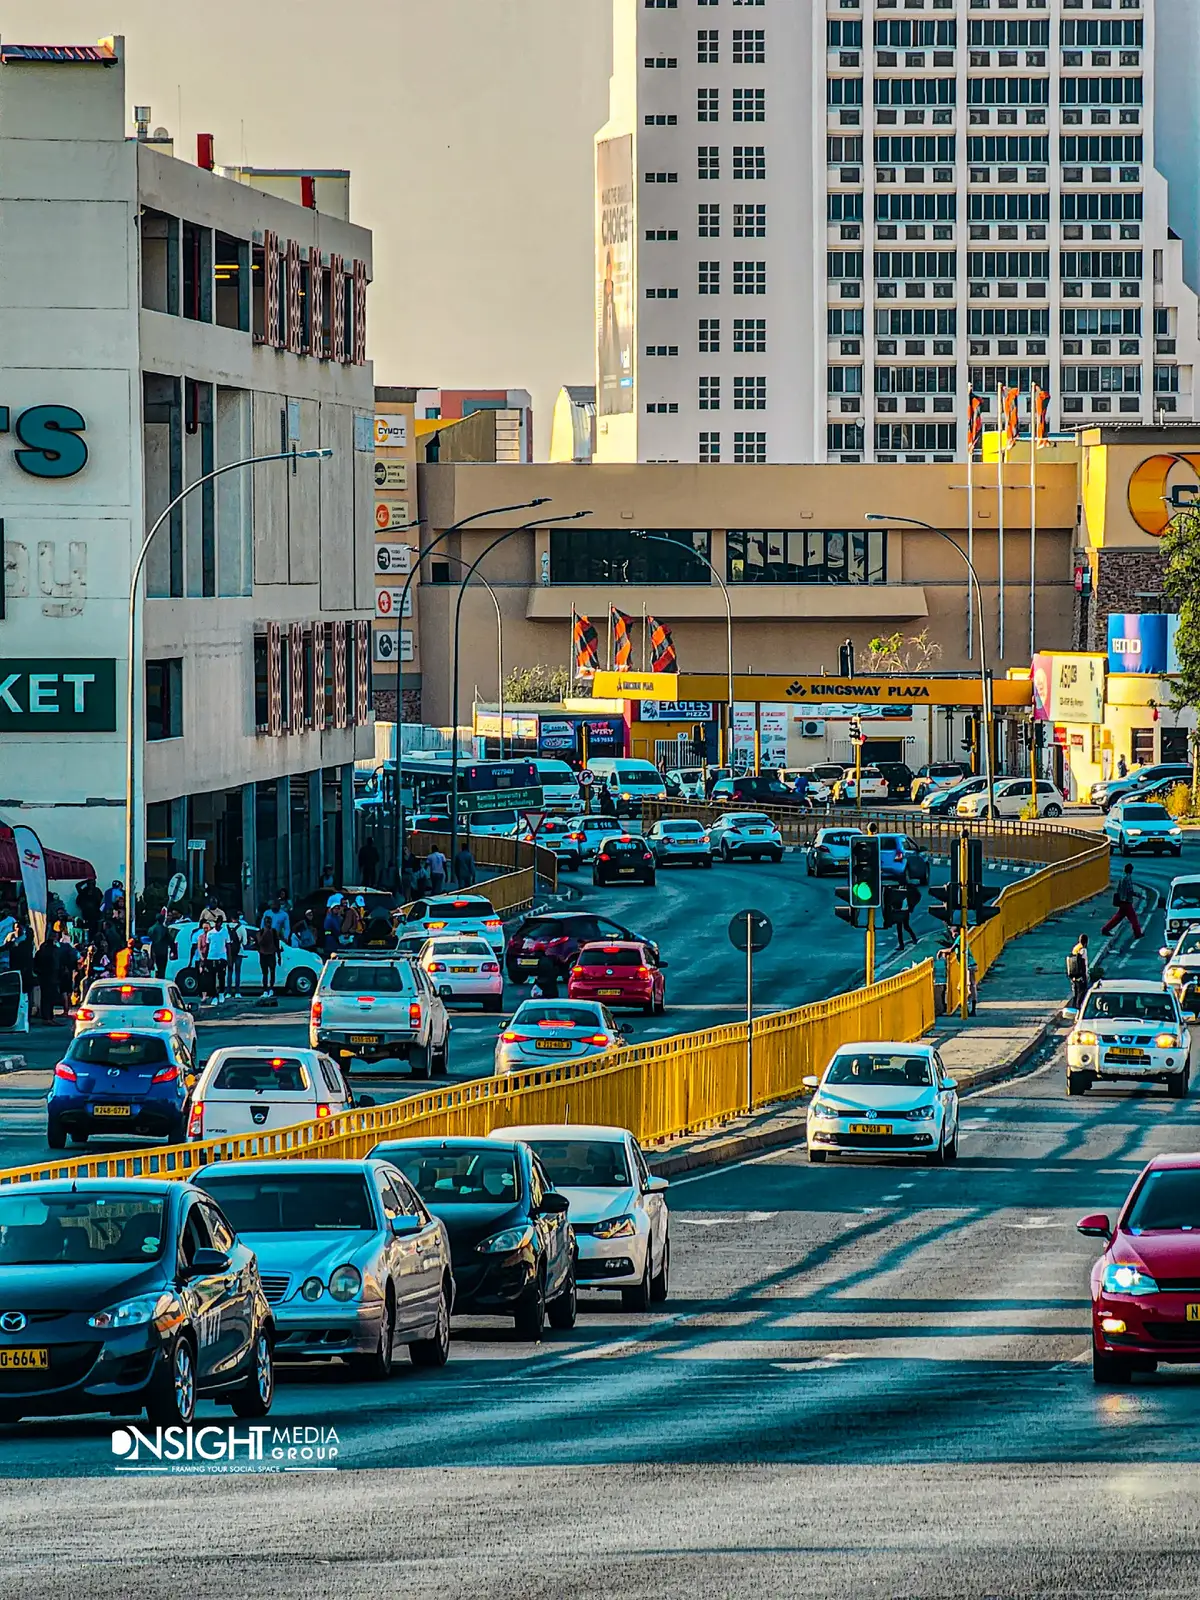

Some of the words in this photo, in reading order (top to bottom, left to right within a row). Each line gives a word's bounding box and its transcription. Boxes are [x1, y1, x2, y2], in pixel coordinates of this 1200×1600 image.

[0, 404, 88, 478] S
[811, 685, 881, 696] KINGSWAY
[888, 687, 930, 697] PLAZA
[659, 701, 710, 710] EAGLES
